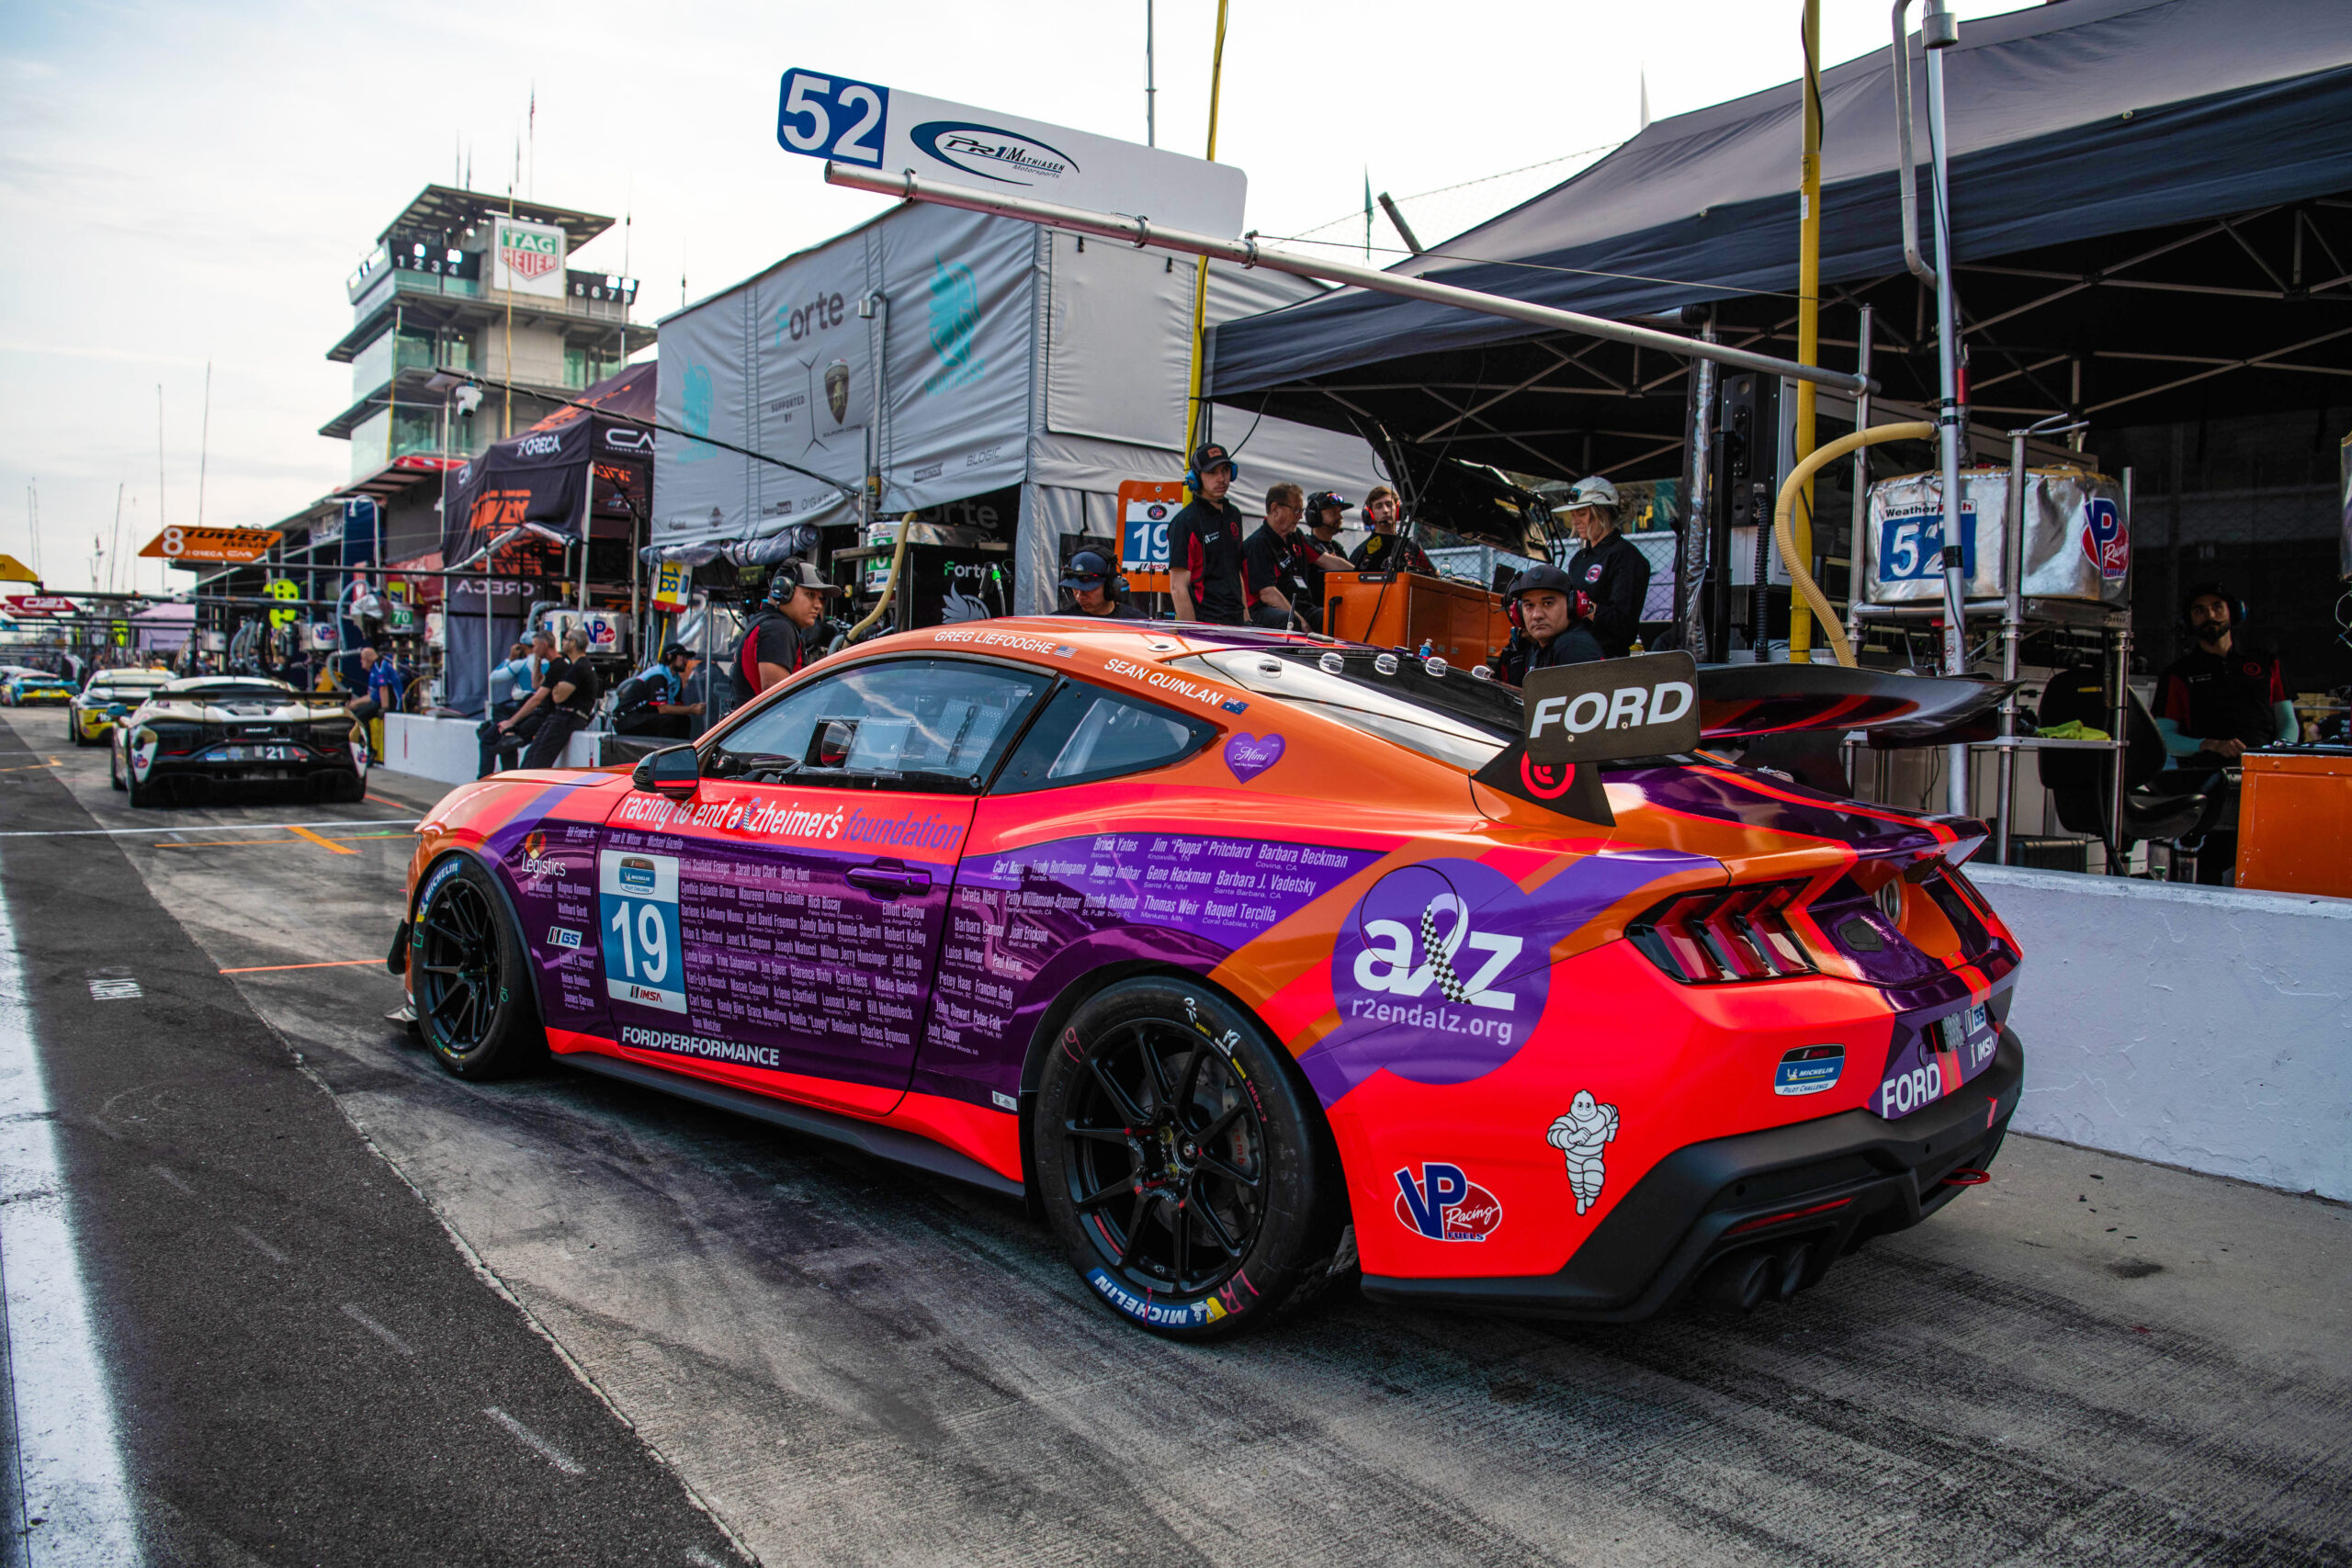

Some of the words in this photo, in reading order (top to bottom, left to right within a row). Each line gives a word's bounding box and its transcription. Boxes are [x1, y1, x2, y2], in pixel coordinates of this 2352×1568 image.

[782, 73, 882, 163] 52
[1012, 164, 1060, 179] Motorsports
[504, 232, 554, 252] TAG
[397, 255, 405, 266] 1
[413, 258, 423, 270] 2
[431, 260, 441, 273] 3
[447, 264, 458, 276] 4
[502, 248, 556, 274] HEUER
[575, 284, 584, 296] 5
[591, 286, 601, 299] 6
[608, 288, 616, 300] 7
[775, 291, 844, 347] Forte
[925, 358, 986, 398] HUNTRESS
[771, 395, 805, 412] SUPPORTED
[785, 413, 792, 423] BY
[526, 434, 561, 456] ORECA
[966, 446, 1001, 467] BLOGIC
[162, 527, 185, 556] 8
[1134, 523, 1170, 560] 19
[2085, 497, 2119, 579] VP
[2103, 541, 2130, 563] Racing
[662, 567, 679, 593] 18
[2105, 569, 2125, 578] FUELS
[393, 611, 410, 624] 70
[584, 621, 606, 643] VP
[934, 630, 972, 643] GREG
[974, 632, 1056, 655] LIEFOOGHE
[1103, 658, 1150, 680] SEAN
[1148, 672, 1223, 705] QUINLAN
[1529, 682, 1693, 739] FORD
[266, 746, 285, 760] 21
[1234, 747, 1269, 761] Mimi
[620, 795, 676, 831] racing
[673, 798, 695, 824] to
[693, 797, 735, 827] end
[842, 807, 964, 851] foundation
[1116, 838, 1138, 852] Yates
[1150, 837, 1168, 852] Jim
[1208, 840, 1253, 860] Pritchard
[521, 852, 566, 879] Legistics
[1259, 844, 1298, 863] Barbara
[1300, 848, 1348, 868] Beckman
[736, 863, 750, 876] Sarah
[752, 864, 762, 877] Lou
[763, 864, 776, 878] Clark
[781, 866, 796, 882] Betty
[797, 867, 809, 881] Hunt
[993, 859, 1009, 873] Carl
[1147, 865, 1168, 881] Gene
[1170, 866, 1212, 885] Hackman
[1285, 863, 1297, 872] CA
[424, 863, 458, 901] MICHELIN
[1216, 870, 1255, 888] Barbara
[1257, 873, 1267, 889] J.
[1271, 874, 1316, 897] Vadetsky
[808, 895, 820, 908] Rich
[822, 897, 842, 913] Biscay
[1108, 894, 1138, 910] Holland
[1269, 891, 1282, 899] CA
[882, 901, 900, 917] Elliott
[902, 904, 925, 920] Caplow
[1144, 895, 1176, 913] Thomas
[1178, 897, 1200, 916] Weir
[1204, 900, 1236, 919] Raquel
[1239, 902, 1277, 922] Tercilla
[746, 911, 757, 925] Joel
[758, 912, 773, 927] David
[774, 914, 797, 930] Freeman
[800, 917, 817, 933] Sandy
[818, 919, 835, 934] Durko
[837, 921, 857, 936] Ronnie
[859, 923, 882, 939] Sherrill
[955, 917, 981, 934] Barbara
[982, 919, 1004, 937] Caruso
[561, 931, 581, 945] GS
[612, 901, 668, 983] 19
[884, 926, 905, 942] Robert
[1010, 924, 1023, 939] Joan
[1024, 926, 1048, 942] Erickson
[749, 935, 771, 951] Simpson
[775, 938, 794, 954] Joseph
[944, 944, 962, 960] Luise
[820, 943, 839, 959] Milton
[841, 946, 856, 964] Jerry
[857, 949, 888, 967] Hunsinger
[892, 953, 904, 967] Jeff
[906, 955, 922, 970] Allen
[992, 953, 1004, 969] Paul
[761, 961, 771, 974] Jim
[772, 962, 787, 976] Speer
[790, 964, 815, 980] Clarence
[835, 970, 852, 986] Carol
[853, 973, 868, 987] Hess
[939, 971, 956, 989] Petey
[957, 975, 972, 991] Haas
[975, 978, 998, 997] Francine
[640, 989, 662, 1003] IMSA
[822, 992, 845, 1009] Leonard
[867, 999, 877, 1014] Bill
[878, 1001, 913, 1021] Hollenbeck
[935, 999, 950, 1015] John
[951, 1003, 970, 1021] Stewart
[1973, 1005, 1985, 1027] GS
[973, 1010, 989, 1027] Peter
[989, 1013, 1001, 1032] Falk
[1351, 998, 1512, 1046] r2endalz.org
[860, 1022, 883, 1040] Charles
[884, 1027, 910, 1044] Bronson
[928, 1022, 941, 1040] Judy
[942, 1025, 961, 1043] Cooper
[1977, 1035, 1996, 1062] IMSA
[1799, 1066, 1835, 1077] MICHELIN
[1782, 1085, 1798, 1093] PILOT
[1799, 1082, 1828, 1092] CHALLENGE
[1883, 1063, 1940, 1119] FORD
[1394, 1162, 1468, 1240] VP
[1446, 1205, 1500, 1230] Racing
[1447, 1231, 1485, 1241] FUELS
[1094, 1275, 1187, 1325] MICHELIN
